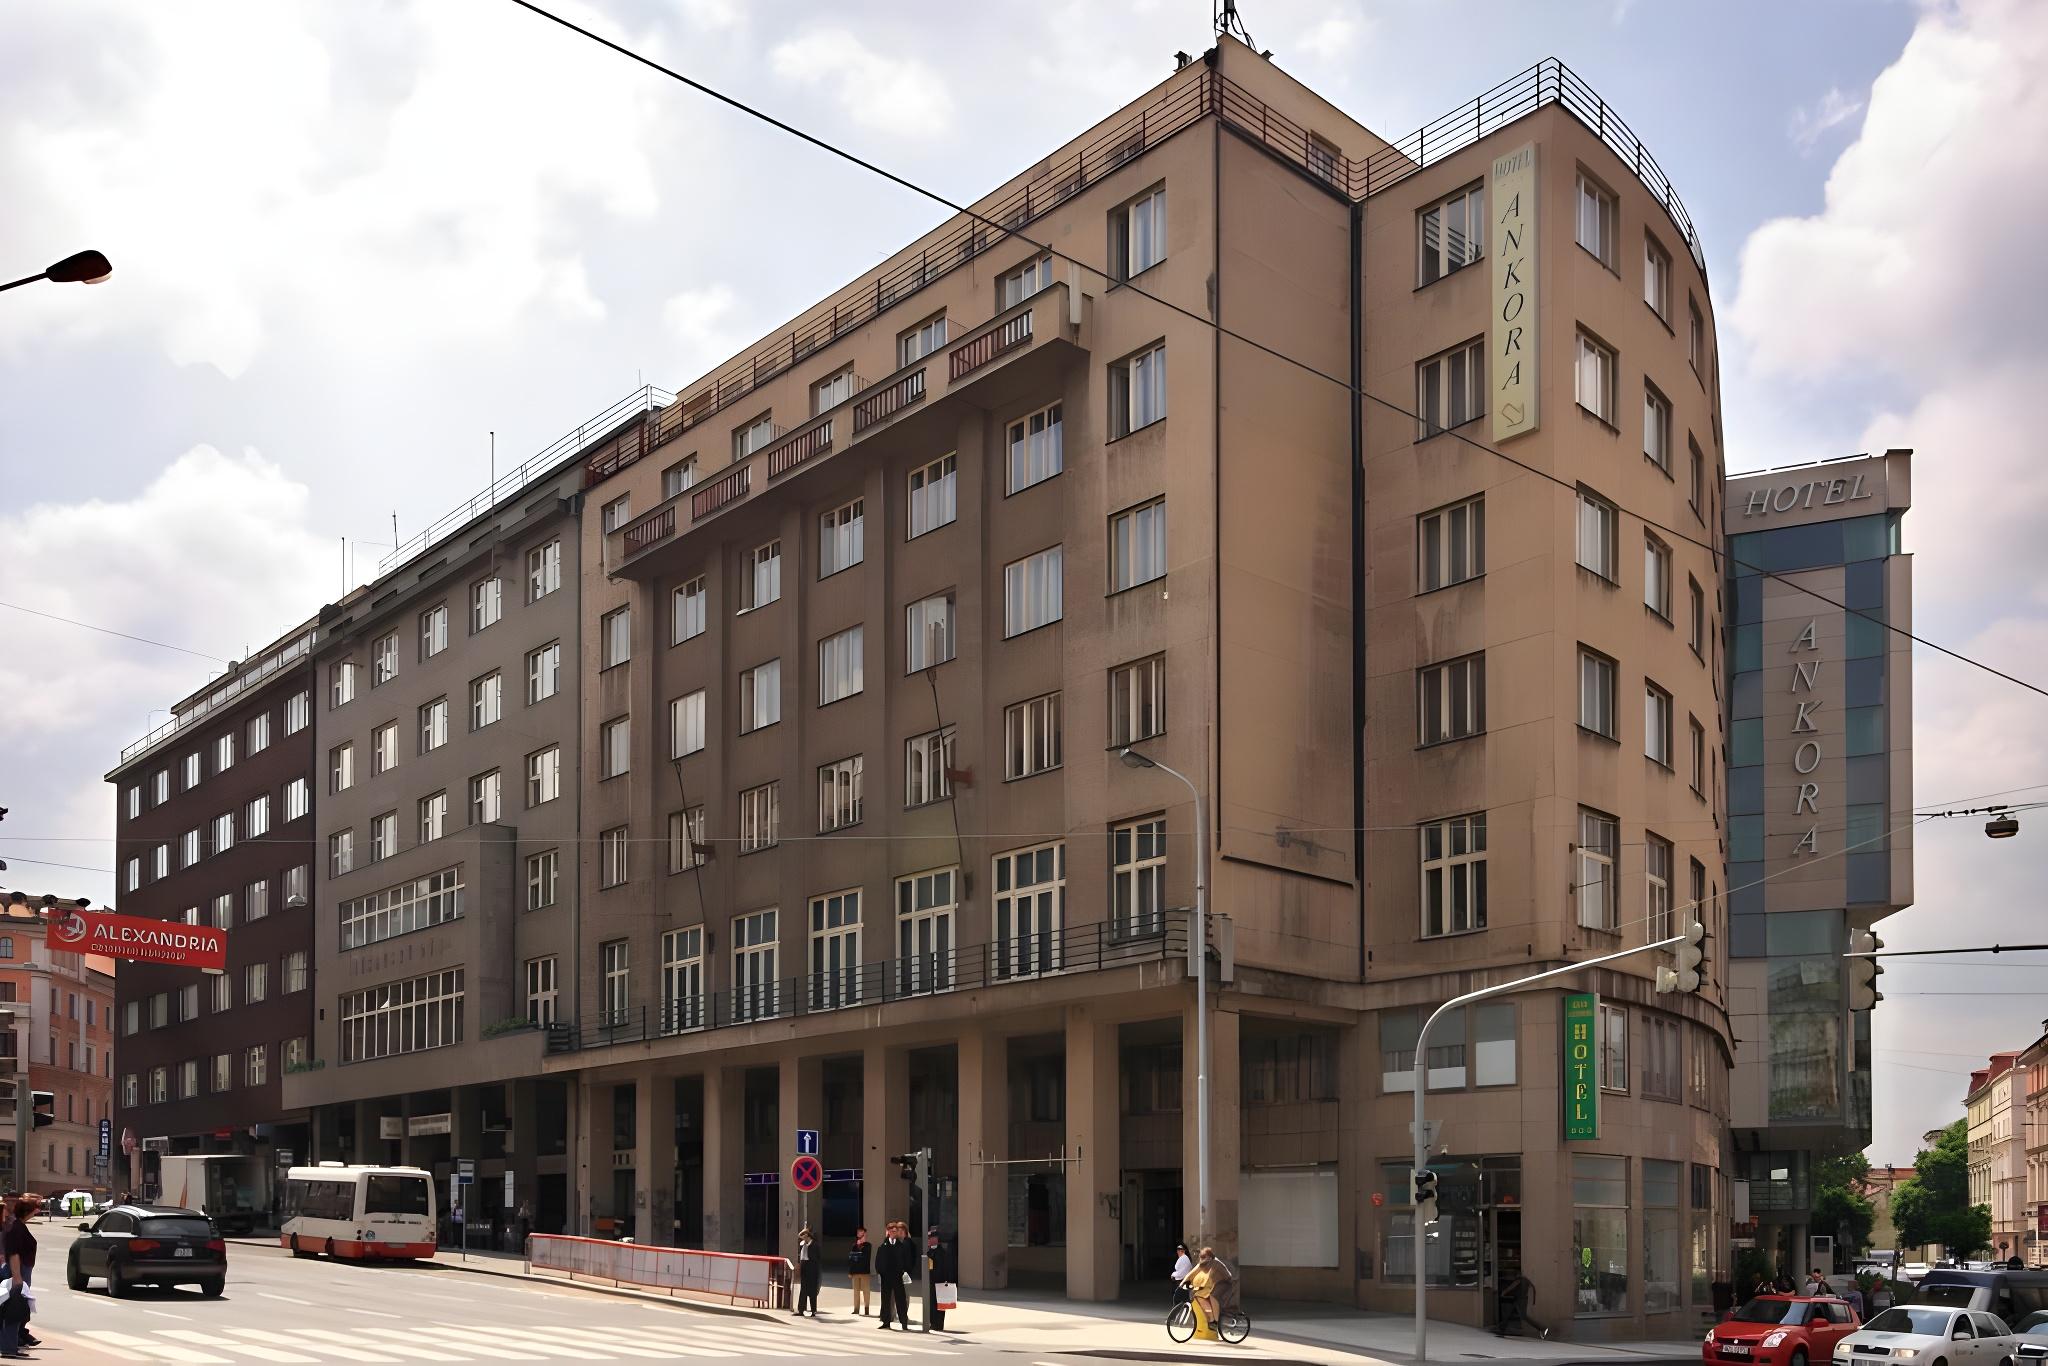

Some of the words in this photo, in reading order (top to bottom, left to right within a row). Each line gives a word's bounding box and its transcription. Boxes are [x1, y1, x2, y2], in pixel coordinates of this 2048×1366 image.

[1501, 191, 1525, 391] ANKORA
[1744, 473, 1873, 518] HOTEL
[1789, 615, 1824, 856] ANKORA
[94, 923, 219, 953] ALEXANDRIA
[1573, 1023, 1588, 1120] HOTEL
